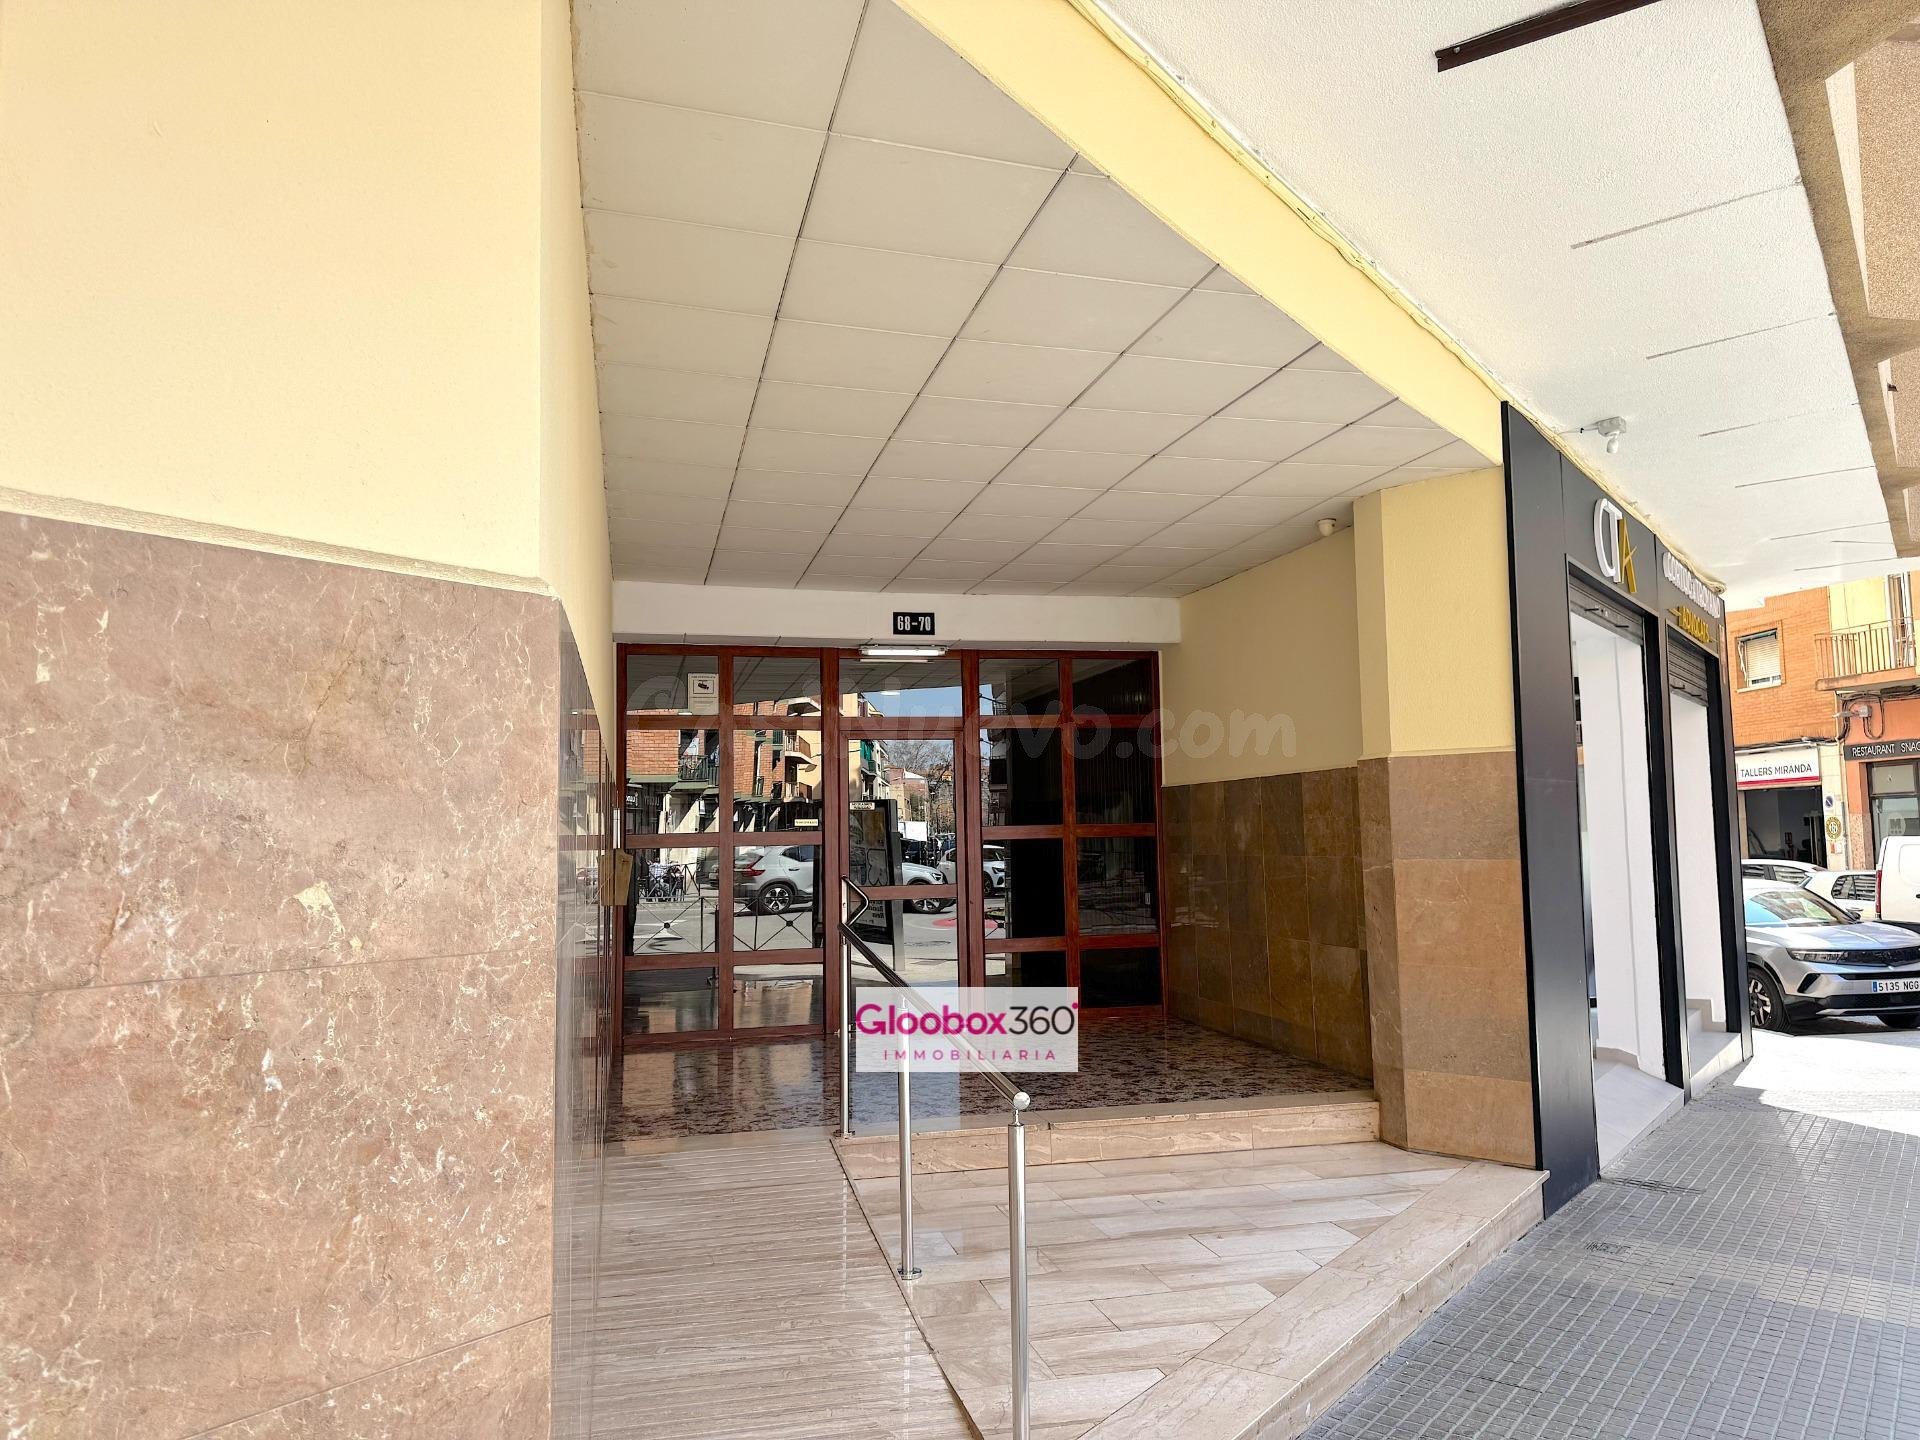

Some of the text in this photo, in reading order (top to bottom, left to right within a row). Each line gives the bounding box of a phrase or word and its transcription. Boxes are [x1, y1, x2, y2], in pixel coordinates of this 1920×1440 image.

[897, 615, 931, 631] 68-70
[1852, 743, 1895, 757] RESTAURANT
[1740, 763, 1812, 778] TALLERS MIRANDA
[1878, 981, 1900, 992] 5135
